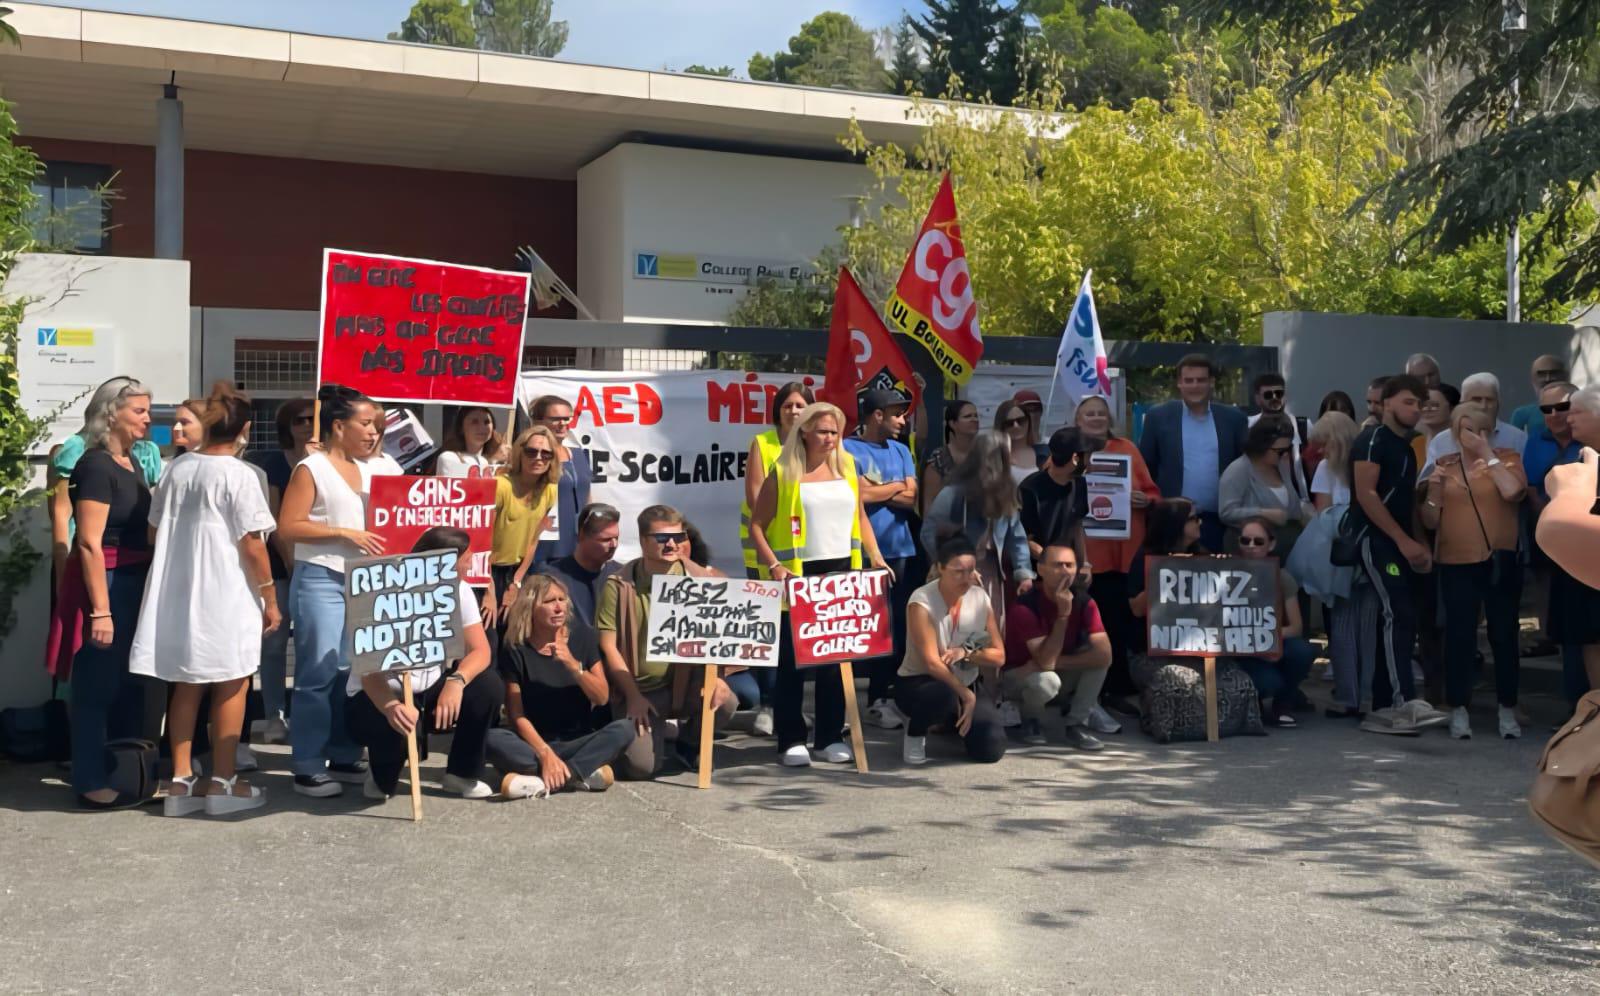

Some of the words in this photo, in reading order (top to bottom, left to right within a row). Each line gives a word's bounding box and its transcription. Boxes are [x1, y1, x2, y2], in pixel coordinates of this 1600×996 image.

[892, 300, 908, 328] UL
[568, 383, 663, 429] AED
[351, 553, 458, 596] RENDEZ
[789, 570, 889, 607] RECTORAT
[373, 585, 456, 622] NOUS
[814, 599, 872, 620] SOURD
[1222, 606, 1277, 630] NOUS
[354, 614, 454, 656] NOTRE
[861, 613, 880, 632] EN
[1151, 618, 1222, 652] NOTRE
[1224, 626, 1274, 653] AED
[381, 640, 445, 671] AED
